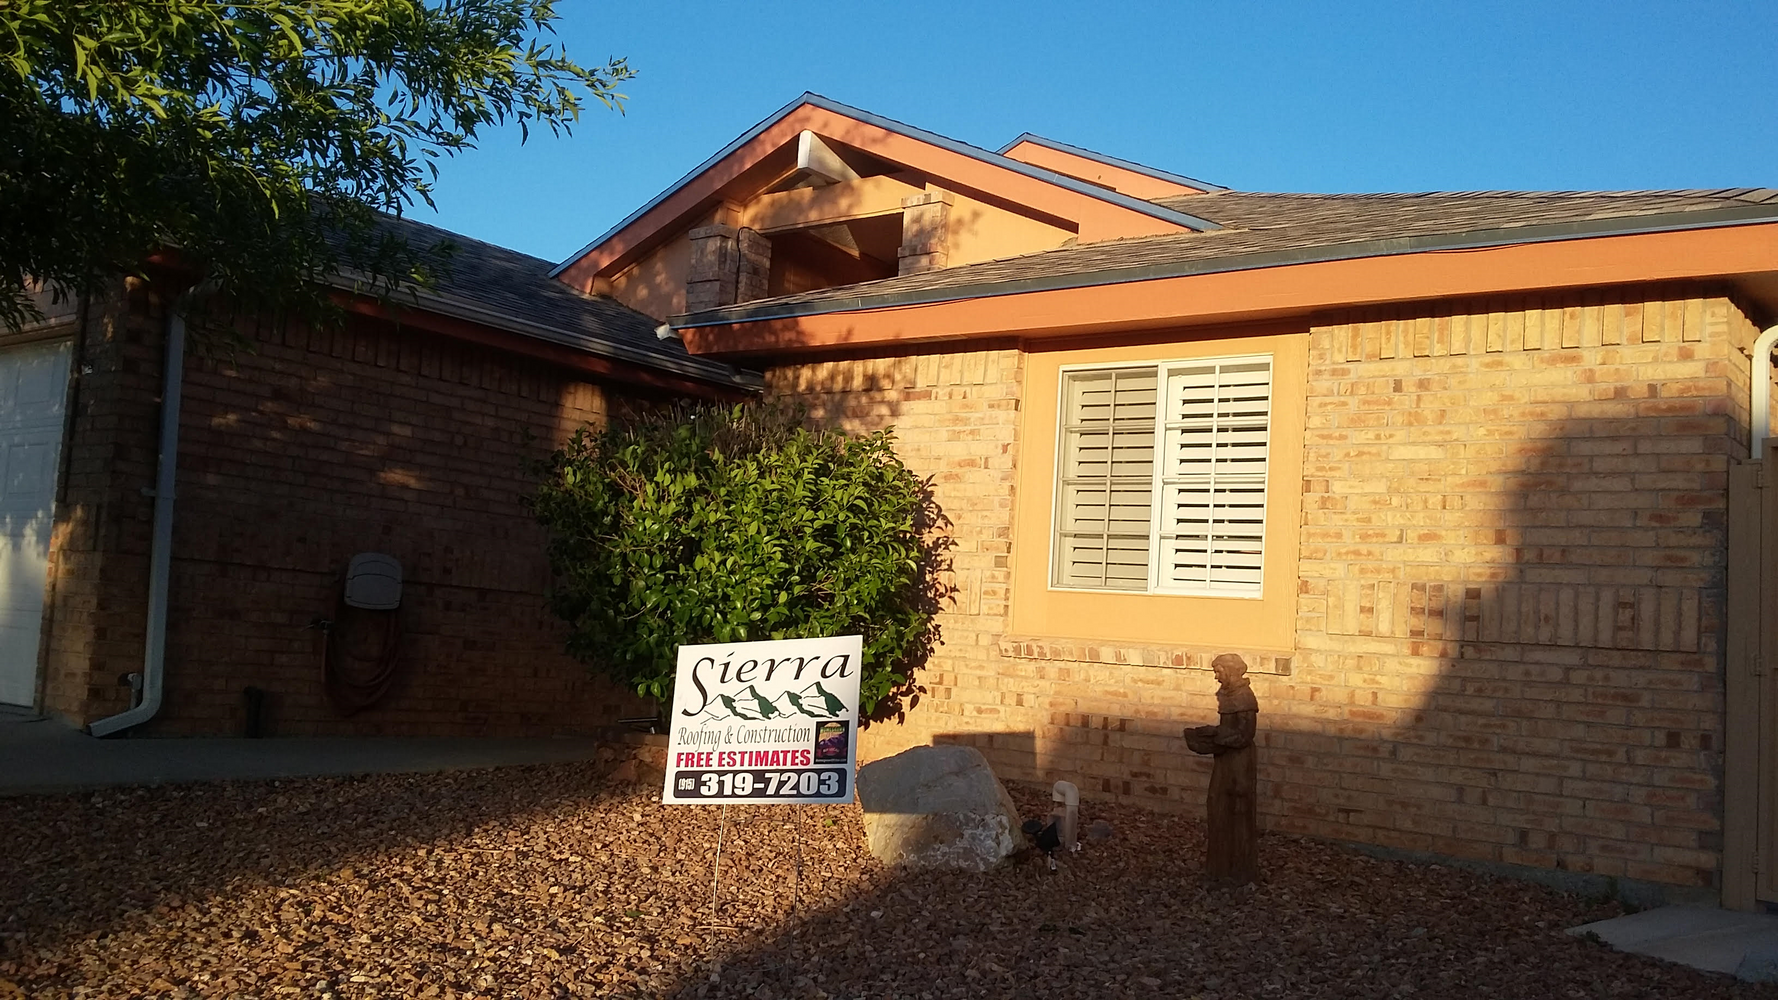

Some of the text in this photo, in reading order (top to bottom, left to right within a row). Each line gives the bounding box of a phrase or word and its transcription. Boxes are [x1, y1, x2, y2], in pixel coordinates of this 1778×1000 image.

[681, 651, 854, 717] Sierra
[677, 723, 811, 752] Roofing & Construction
[675, 751, 713, 768] FREE
[717, 749, 811, 767] ESTIMATES
[700, 771, 839, 796] 319-7203
